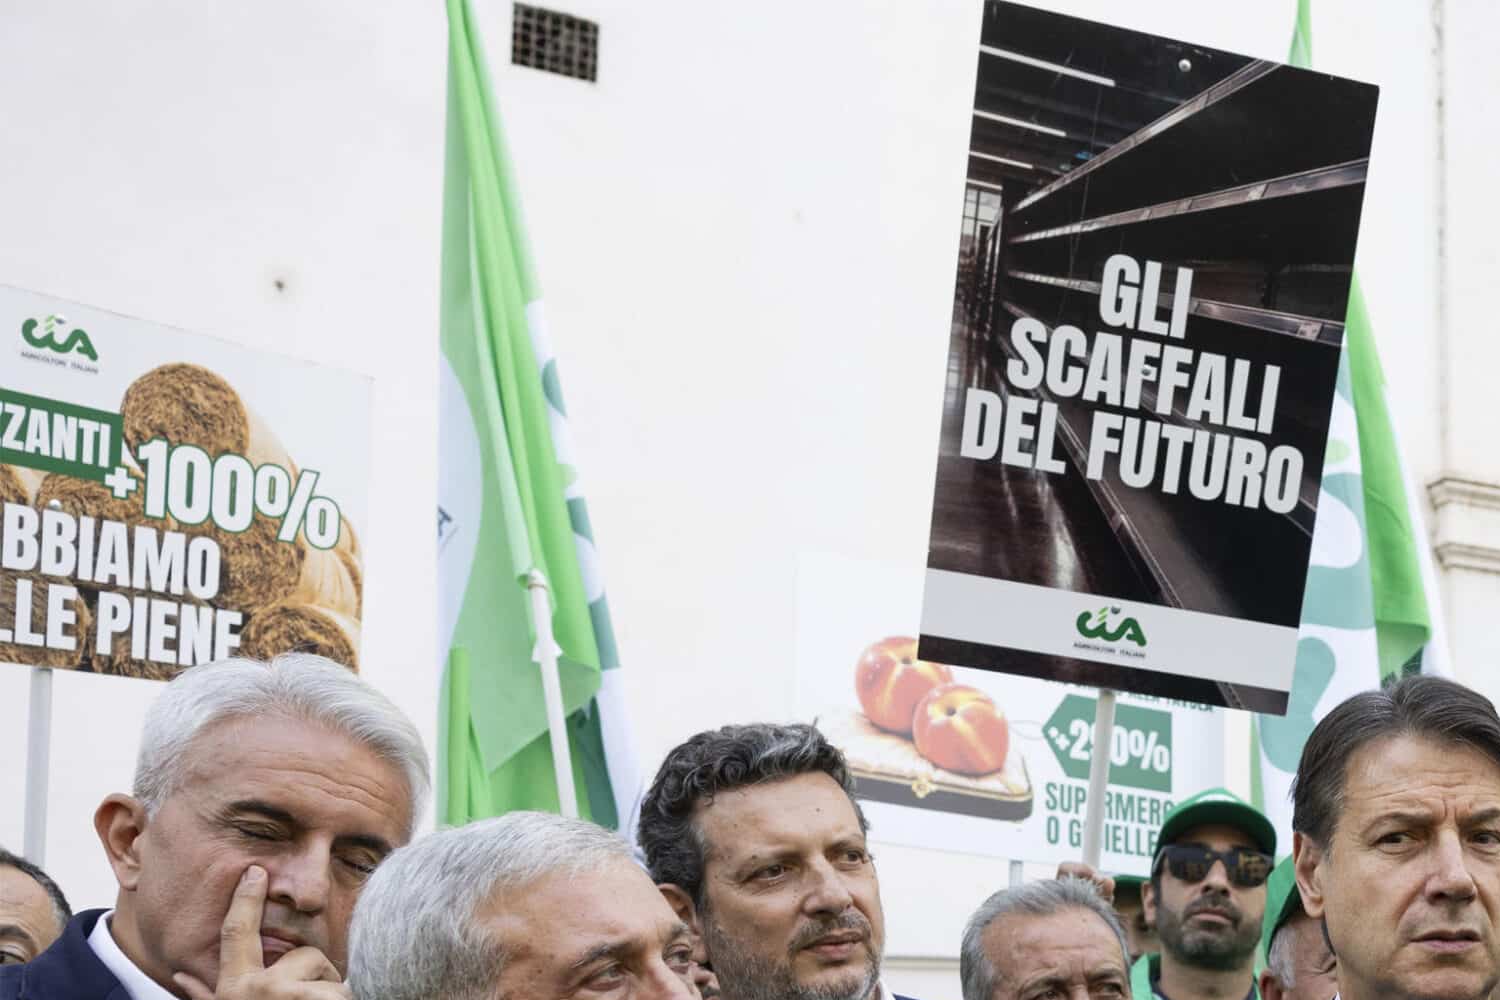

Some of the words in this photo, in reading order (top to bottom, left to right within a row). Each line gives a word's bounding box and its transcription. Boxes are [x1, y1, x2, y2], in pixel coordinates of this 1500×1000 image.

[1099, 253, 1194, 340] GLI
[1006, 317, 1281, 435] SCAFFALI
[0, 401, 111, 468] ZANTI
[960, 387, 1067, 475] DEL
[1086, 410, 1304, 514] FUTURO
[103, 437, 341, 551] +100%
[1, 502, 221, 600] BBIAMO
[1055, 718, 1170, 773] +20%
[1045, 781, 1176, 826] SUPRMERC
[1046, 815, 1060, 845] O
